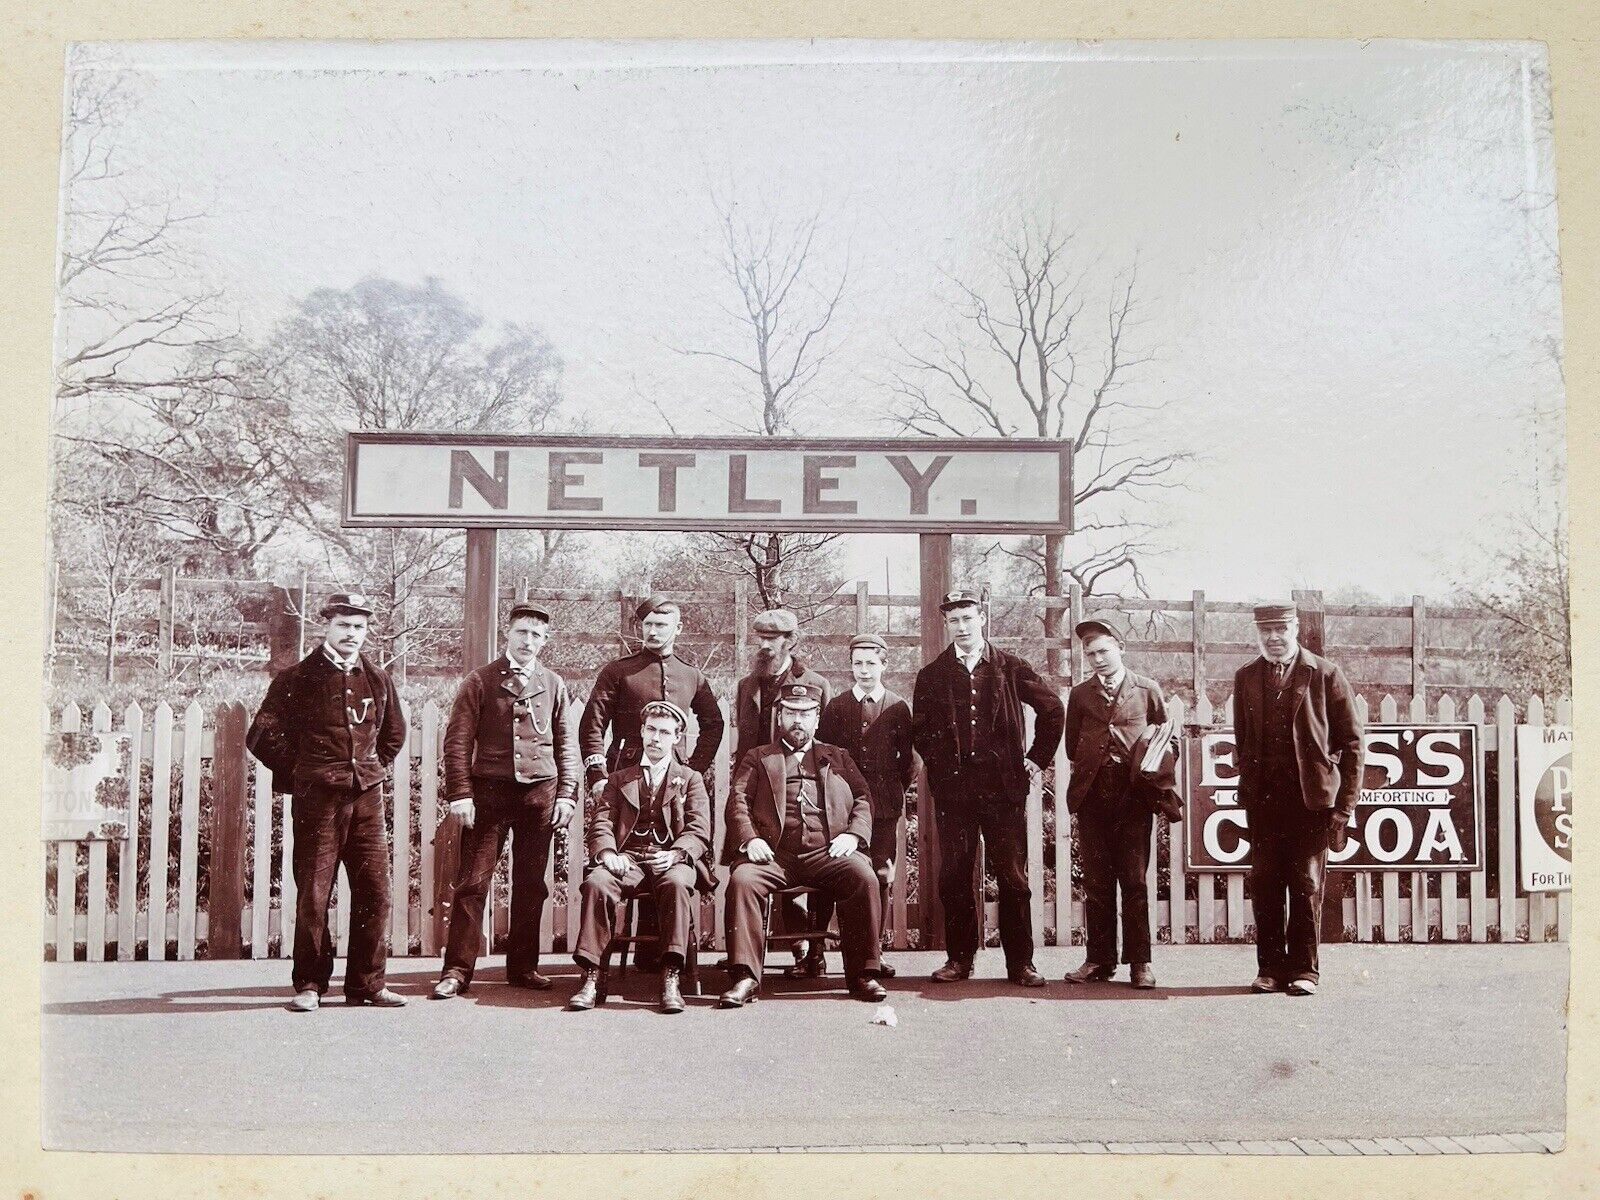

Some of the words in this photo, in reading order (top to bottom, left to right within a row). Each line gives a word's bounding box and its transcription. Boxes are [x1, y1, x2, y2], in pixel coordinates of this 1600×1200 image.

[449, 449, 977, 515] NETLEY.
[1199, 730, 1465, 788] ES'S
[1203, 807, 1468, 864] COA
